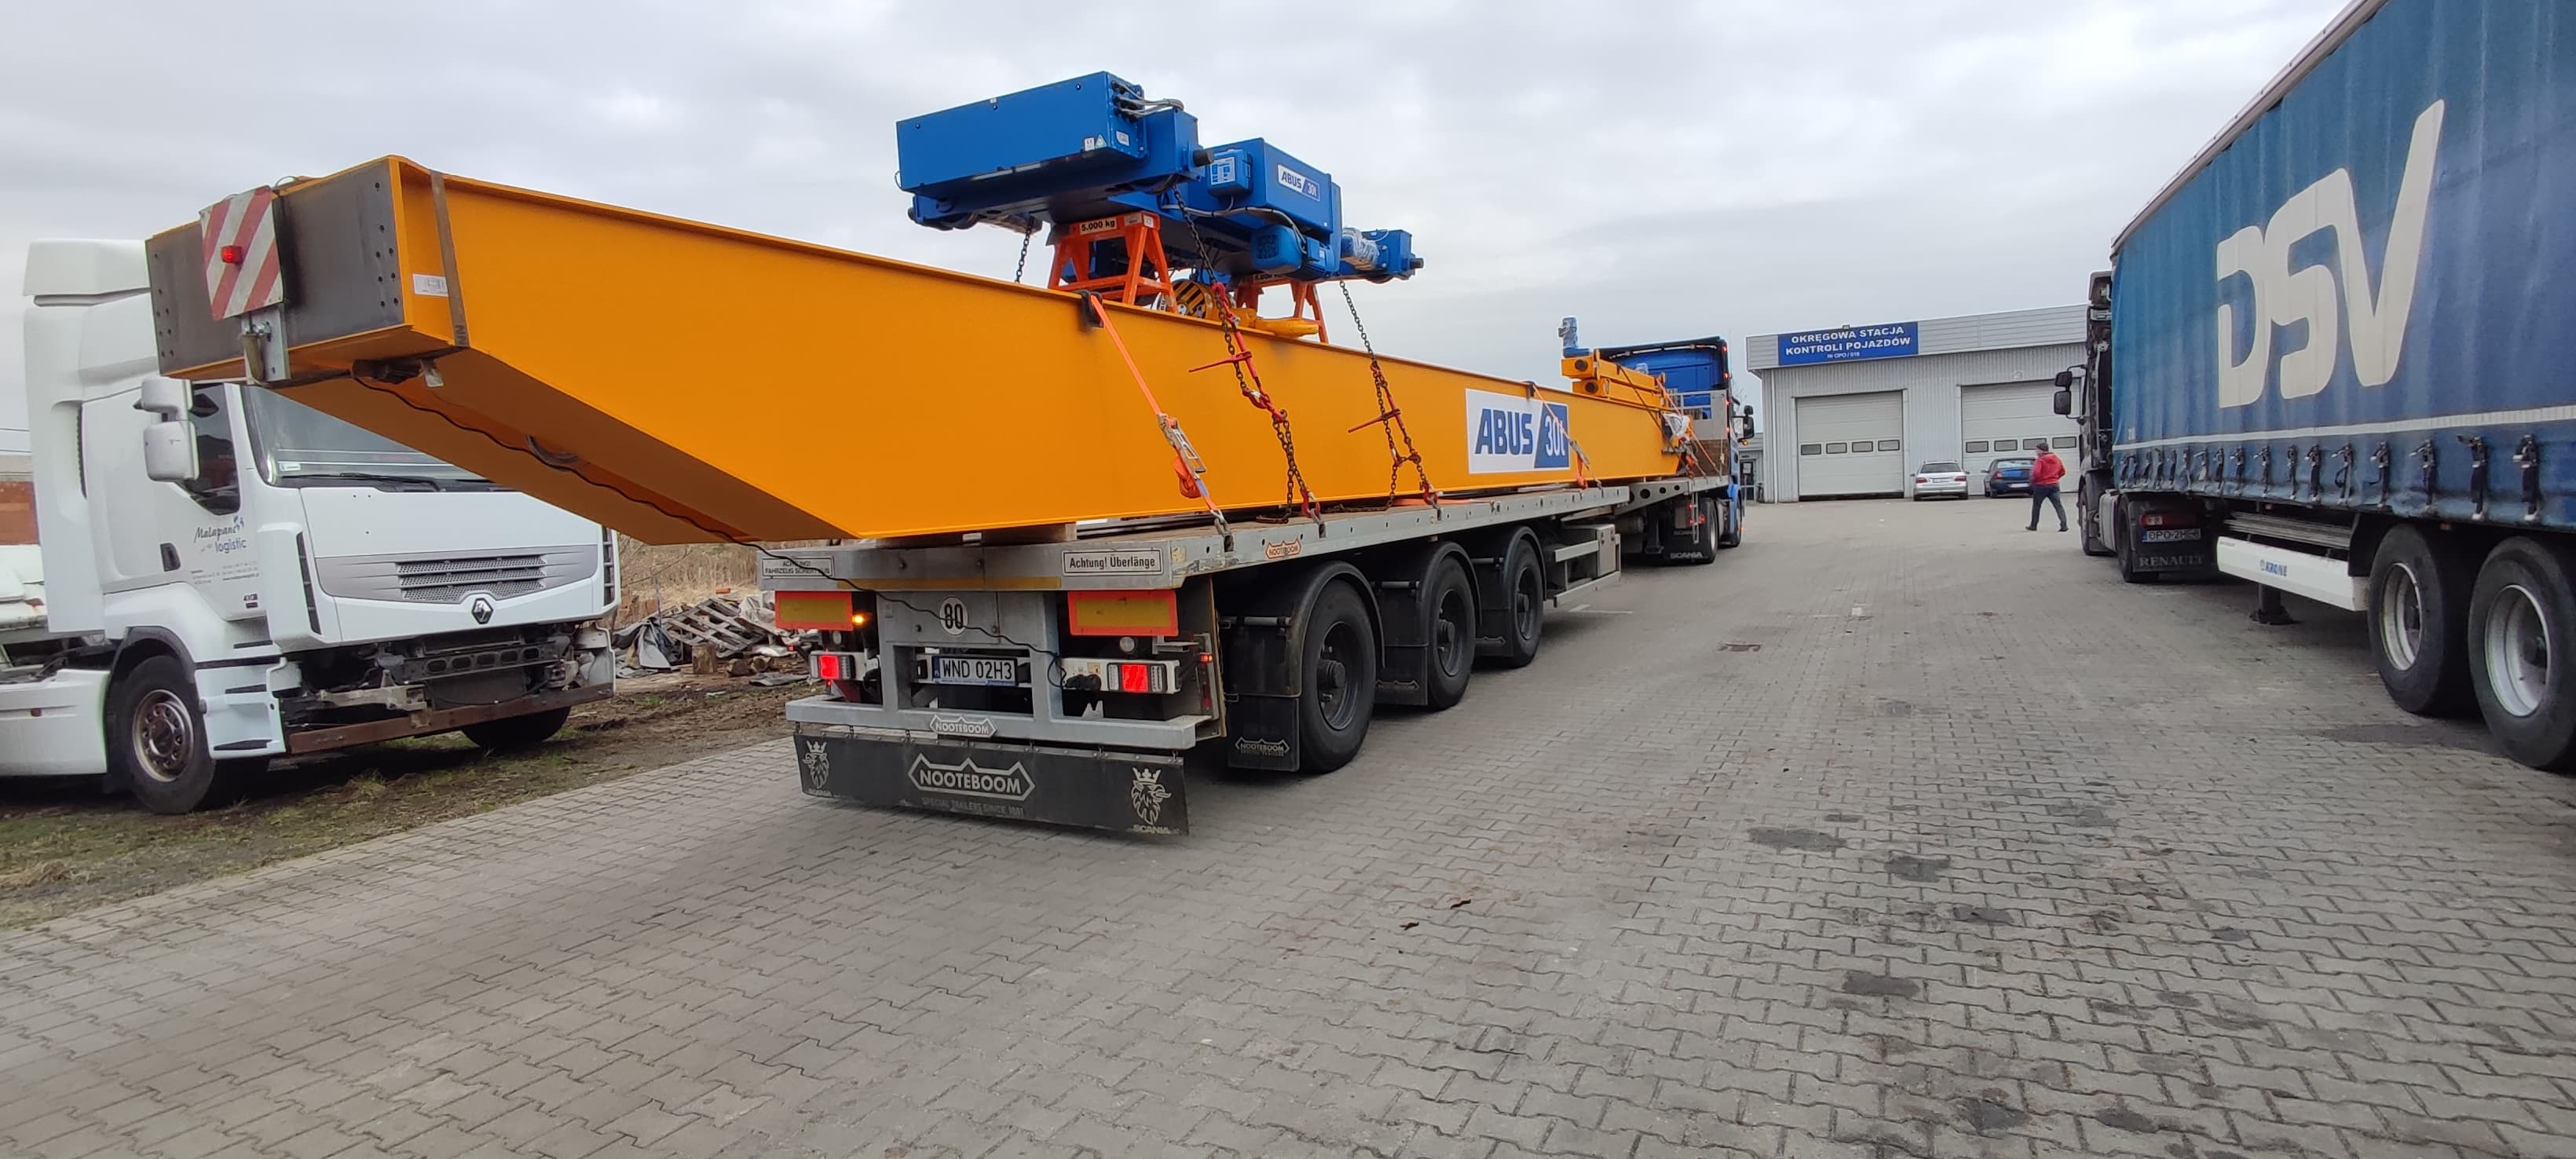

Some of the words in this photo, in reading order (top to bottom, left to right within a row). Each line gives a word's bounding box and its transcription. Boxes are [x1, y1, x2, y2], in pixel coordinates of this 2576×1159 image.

[1282, 171, 1302, 189] ABUS
[1081, 221, 1103, 232] 5.000
[2217, 99, 2444, 408] DSV
[1791, 331, 1857, 344] OKRĘGOWA
[1859, 326, 1905, 338] STACJA
[1785, 343, 1842, 356] KONTROLI
[1846, 337, 1911, 351] POJAZDÓW
[1475, 408, 1534, 455] ABUS
[214, 537, 247, 554] logistic
[1069, 557, 1107, 570] Achtung!
[1110, 554, 1155, 569] Überlänge
[2138, 554, 2204, 566] RENAULT
[944, 603, 964, 630] 80
[943, 660, 971, 678] WND
[975, 661, 1012, 680] 02H3
[935, 722, 990, 734] NOOTEBOOM
[920, 770, 1022, 795] NOOTEBOOM
[1132, 824, 1170, 834] SCANIA
